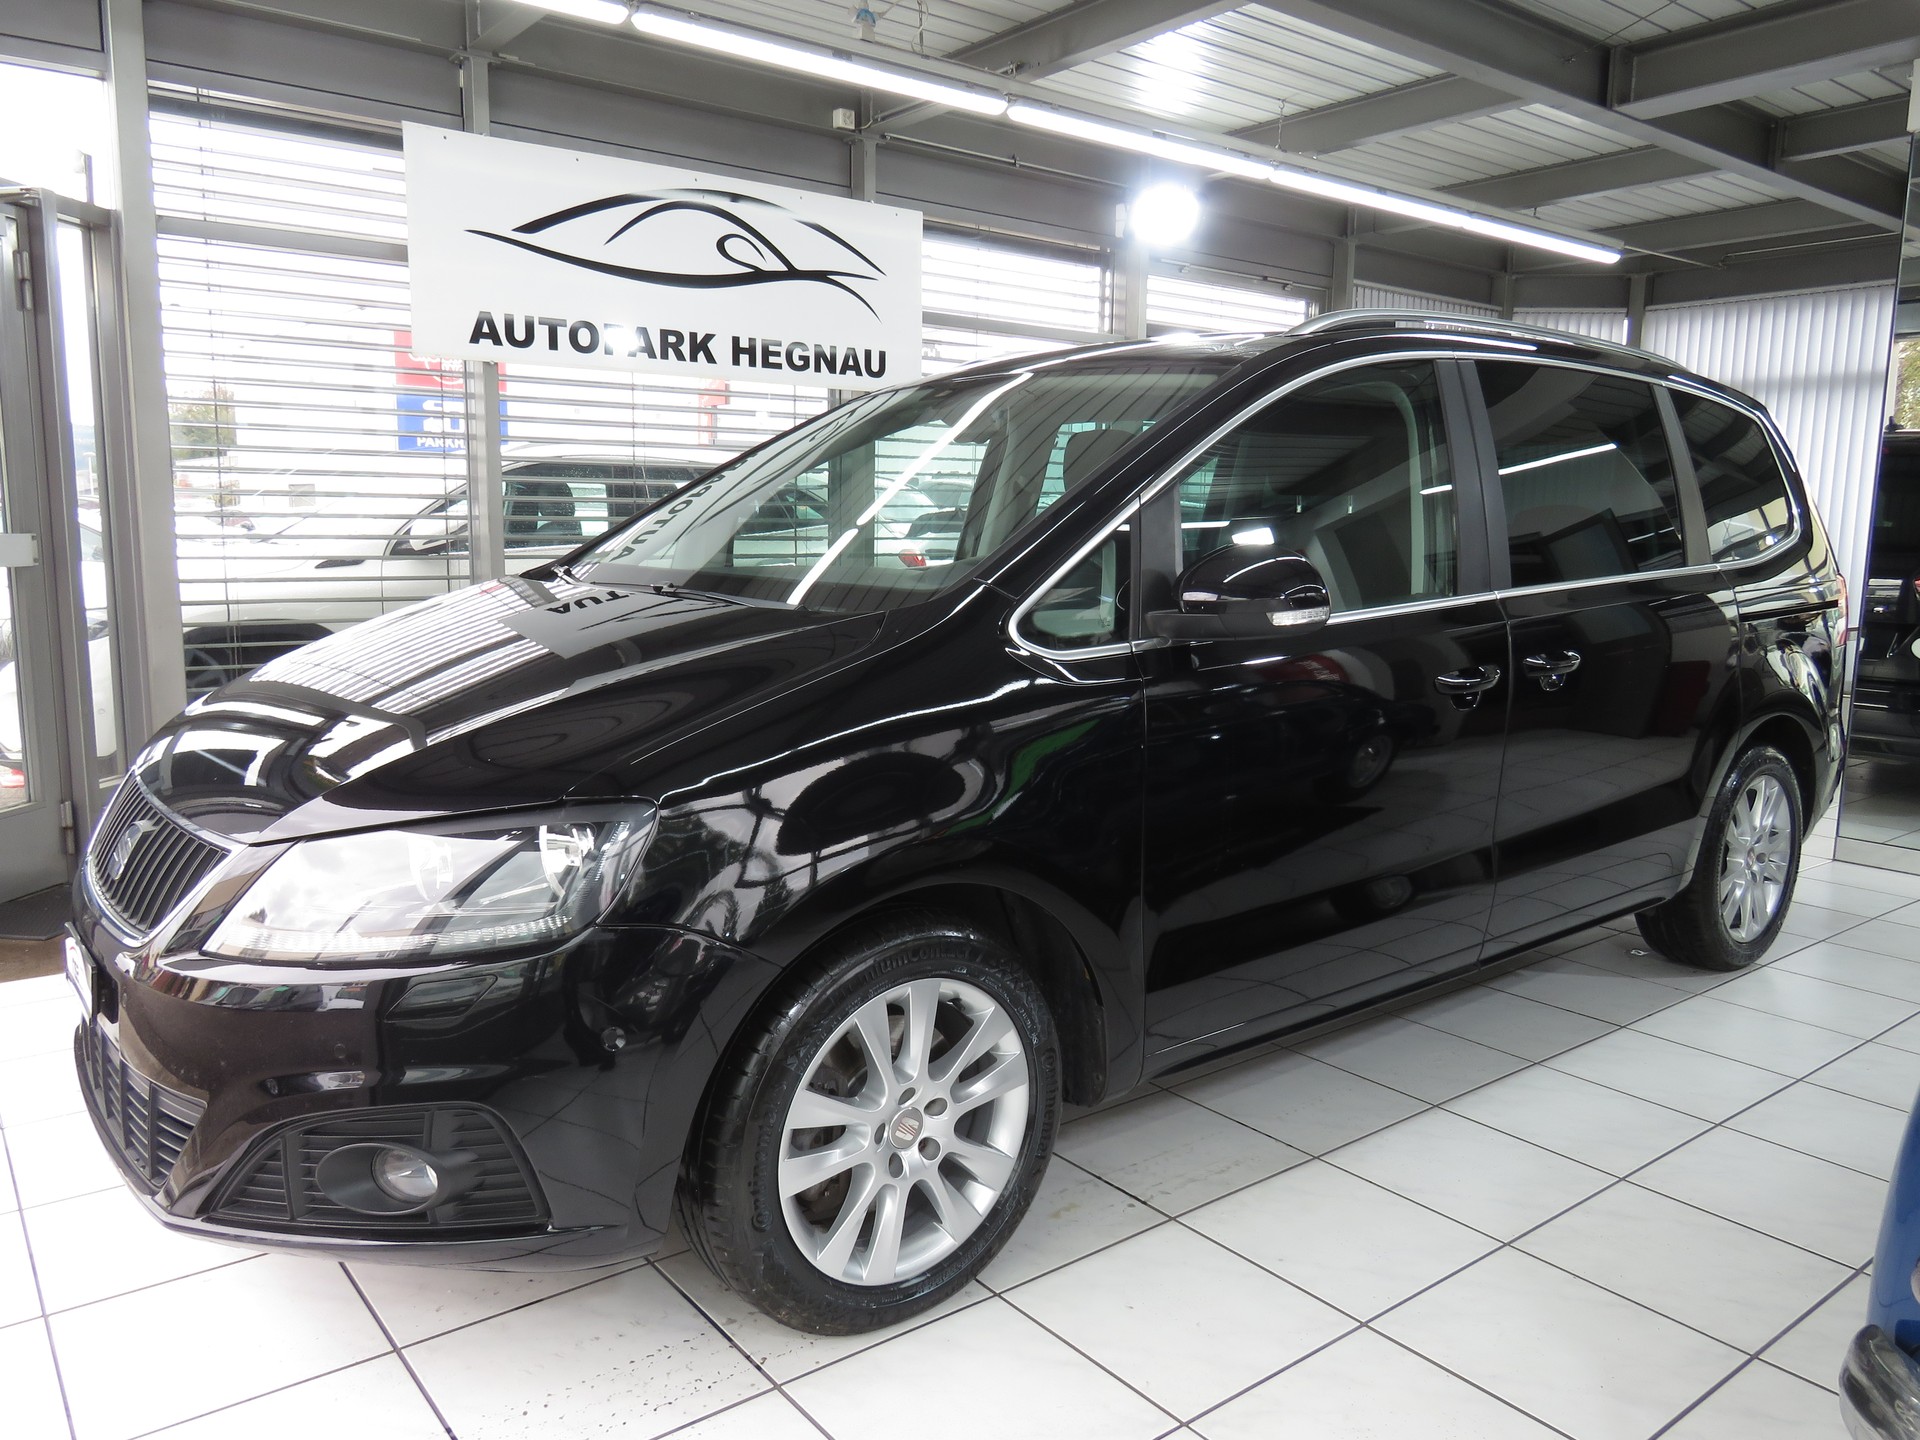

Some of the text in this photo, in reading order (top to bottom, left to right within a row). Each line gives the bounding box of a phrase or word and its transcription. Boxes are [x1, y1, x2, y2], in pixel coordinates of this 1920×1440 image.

[469, 310, 886, 379] AUTOARK HEGNAU
[416, 436, 466, 449] PARKH
[1035, 1046, 1059, 1160] Continental
